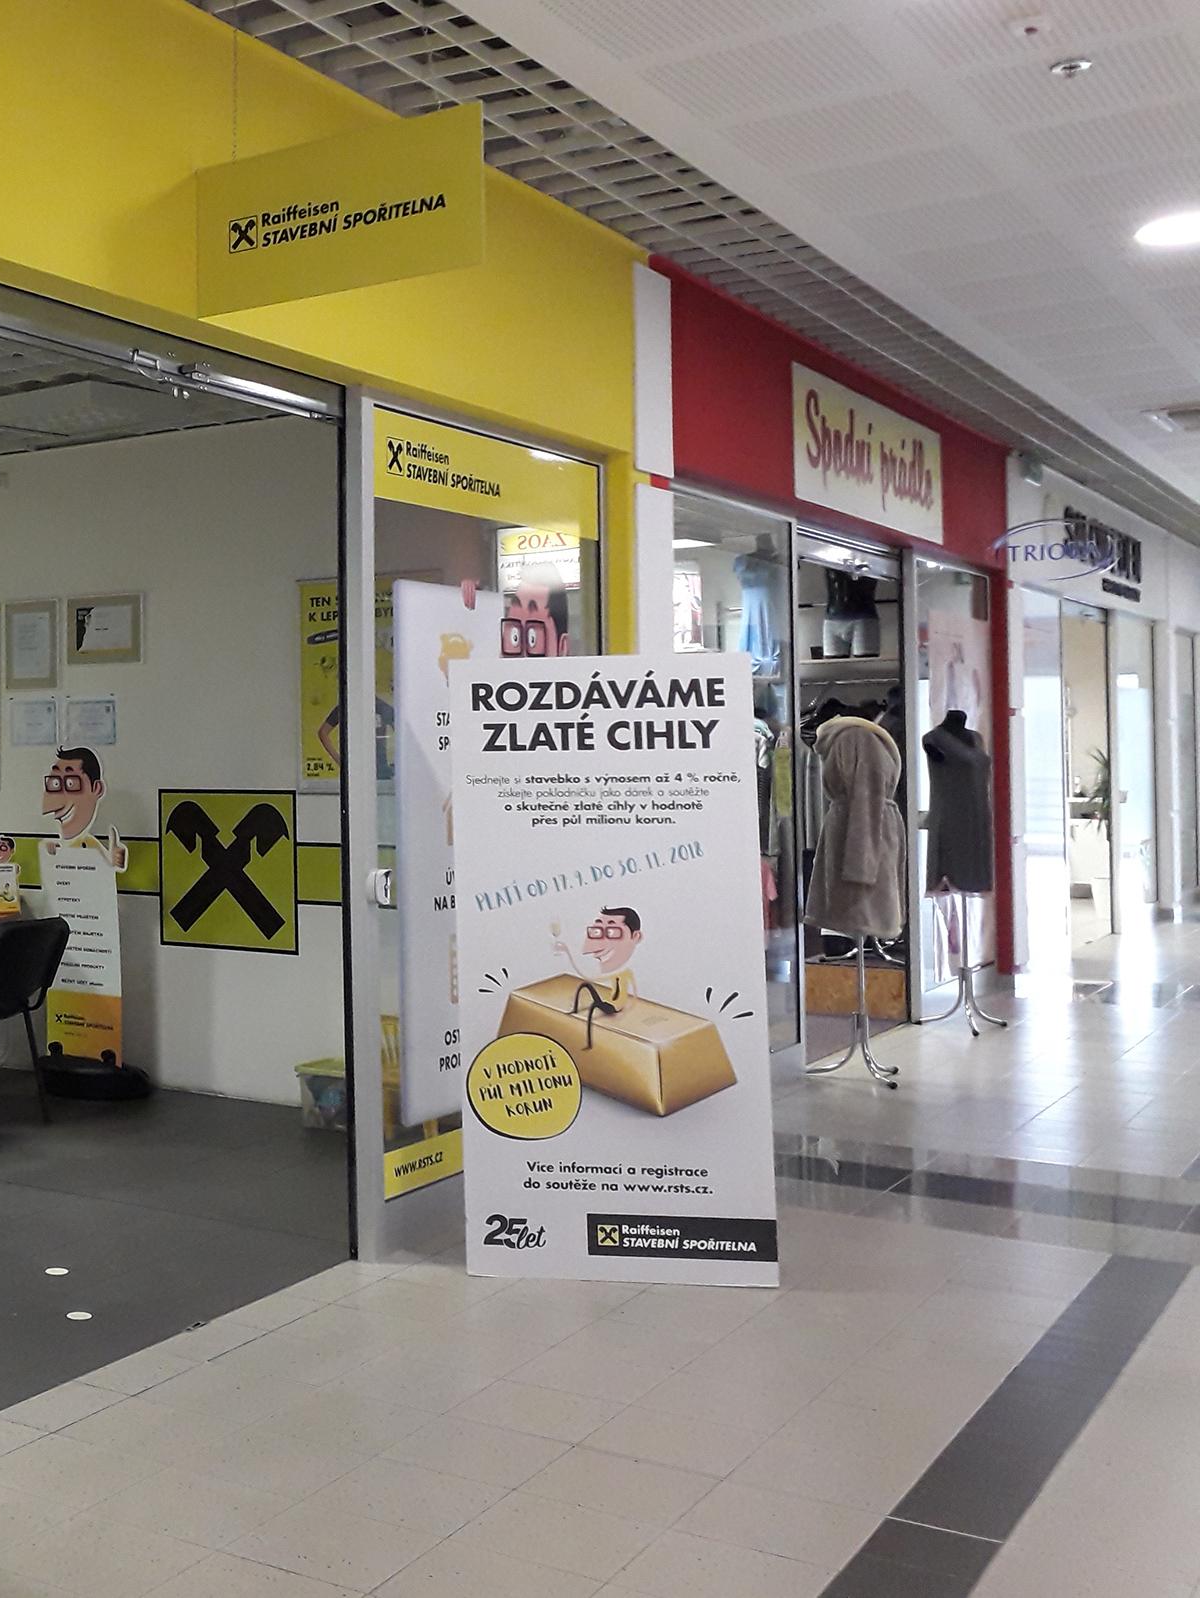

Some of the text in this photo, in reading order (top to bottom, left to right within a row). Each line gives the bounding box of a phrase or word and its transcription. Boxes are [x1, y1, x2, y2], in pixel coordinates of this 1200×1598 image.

[261, 200, 340, 227] Raiffeisen
[261, 193, 446, 247] STAVEBNÍ SPOŘITELNA
[406, 441, 450, 465] Raiffeisen
[406, 463, 501, 497] STAVEBNÍ SPOŘITELNA
[309, 597, 331, 608] TEN
[308, 611, 339, 622] K LEP
[471, 669, 726, 711] ROZDÁVÁME
[482, 712, 720, 752] ZLATÉ CIHLY
[466, 771, 741, 787] Sjednejte si stavebko s výnosem až 4 % ročně,
[497, 786, 710, 800] získejte pokladničku jako dárek a soutěžte
[504, 800, 704, 813] o skutečné zlaté cihly v hodnotě
[532, 814, 676, 827] přes půl milionu korun.
[475, 886, 523, 912] PLATÍ
[527, 880, 548, 897] OD
[590, 864, 614, 882] DO
[670, 841, 704, 864] 2018
[434, 896, 449, 911] NA
[484, 1050, 558, 1079] V HODNOTĚ
[479, 1074, 573, 1102] PŮL MILIONU
[505, 1098, 553, 1117] KORUN
[394, 1151, 443, 1178] WWW.RSTS.CZ
[527, 1161, 708, 1180] Více informací a registrace
[523, 1177, 713, 1195] do soutěže na www.rsts.cz.
[622, 1225, 680, 1236] Raiffeisen
[622, 1235, 757, 1253] STAVEBNÍ SPOŘITELNA
